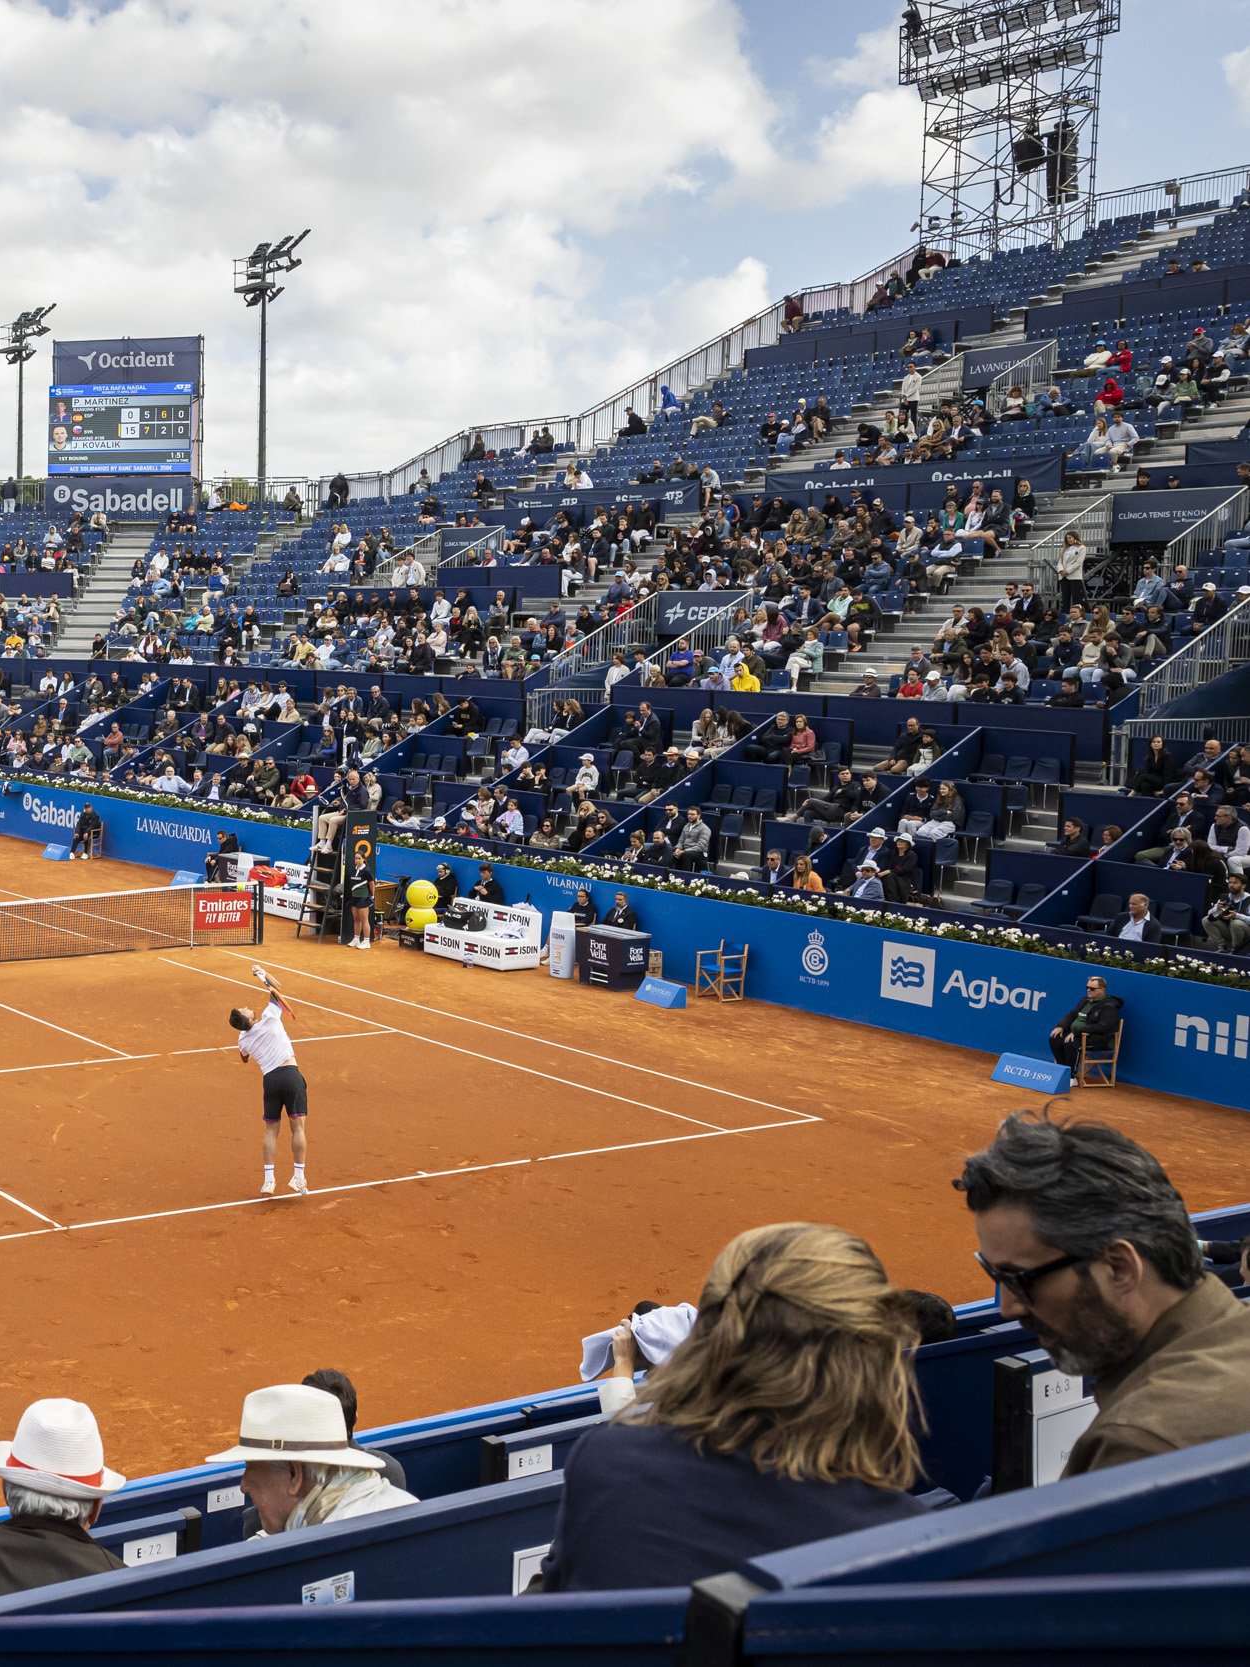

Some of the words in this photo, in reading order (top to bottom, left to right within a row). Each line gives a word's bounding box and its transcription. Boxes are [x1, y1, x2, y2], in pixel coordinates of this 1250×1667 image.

[98, 350, 175, 369] Occident
[73, 398, 82, 406] P.
[84, 397, 129, 406] MARTINEZ
[127, 411, 133, 419] 0
[178, 410, 184, 418] 0
[126, 427, 136, 435] 15
[144, 426, 150, 434] 7
[161, 426, 167, 434] 2
[82, 441, 121, 449] KOVALIK
[71, 488, 183, 512] Sabadell
[664, 490, 684, 500] ATP
[560, 498, 578, 506] ATP
[1118, 511, 1148, 520] CLÍNICA
[1149, 510, 1171, 518] TENIS
[1172, 509, 1207, 517] TEKNON
[32, 798, 81, 829] Sabade
[136, 817, 148, 833] LA
[148, 819, 212, 845] VANGUARDIA
[286, 867, 301, 878] ISDIN
[546, 875, 592, 893] VILARNAU
[199, 898, 249, 913] Emirates
[205, 913, 217, 924] FLY
[217, 912, 241, 923] BETTER
[552, 932, 565, 941] ISDIN
[440, 935, 461, 950] ISDIN
[590, 939, 607, 951] Font
[479, 945, 501, 959] ISDIN
[519, 945, 538, 955] ISDIN
[590, 949, 607, 961] Vella
[630, 947, 644, 955] Font
[629, 954, 644, 962] Vella
[942, 969, 1047, 1012] Agbar
